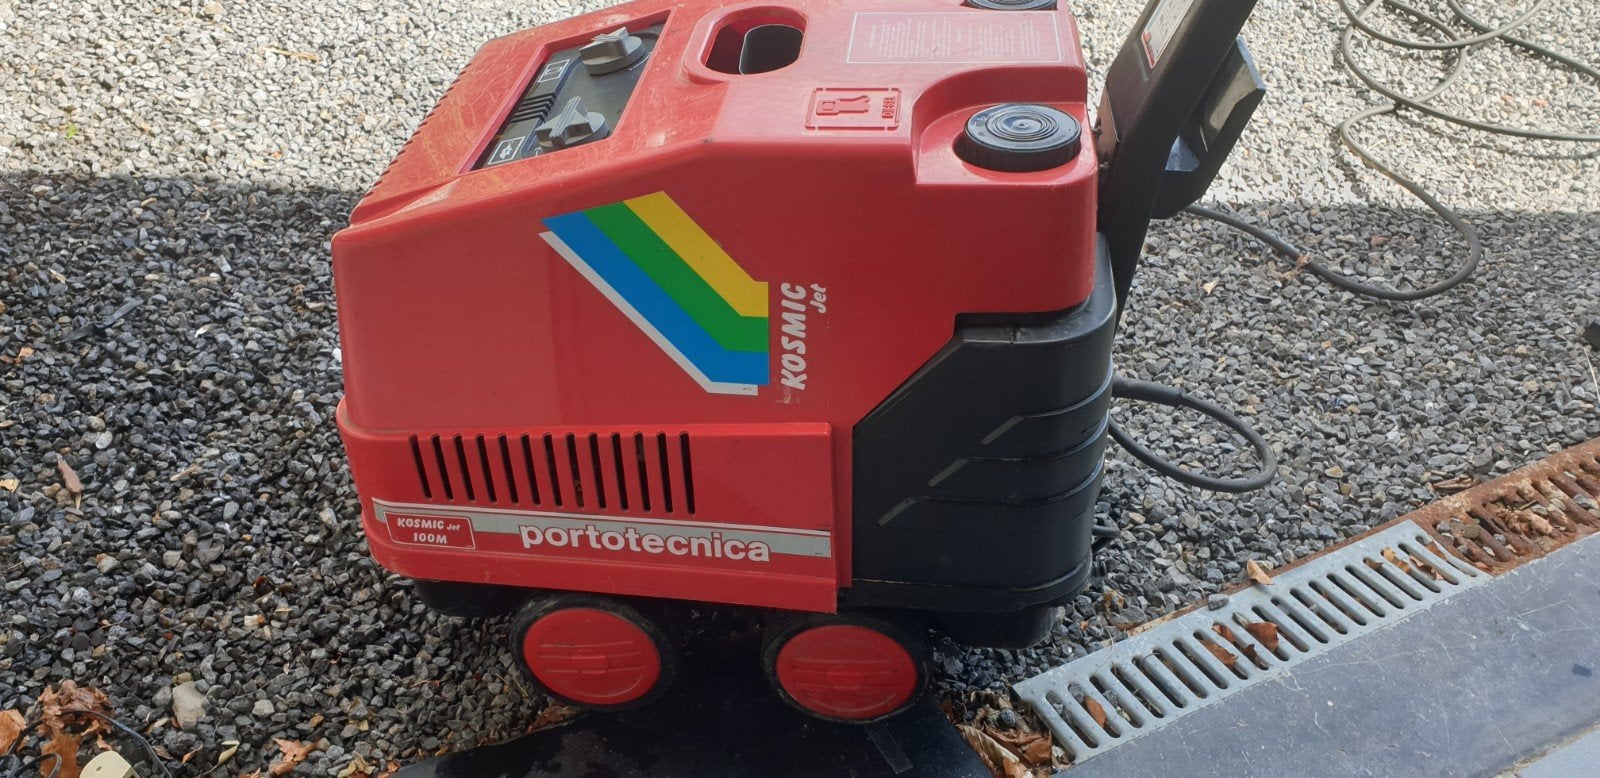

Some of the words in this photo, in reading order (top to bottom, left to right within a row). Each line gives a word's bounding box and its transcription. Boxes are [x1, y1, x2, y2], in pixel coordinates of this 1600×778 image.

[809, 283, 827, 313] Jet
[781, 283, 807, 390] KOSMIC
[397, 517, 444, 530] KOSMIC
[446, 523, 460, 531] Jet
[413, 532, 447, 544] 100M
[519, 524, 770, 562] portotecnica
